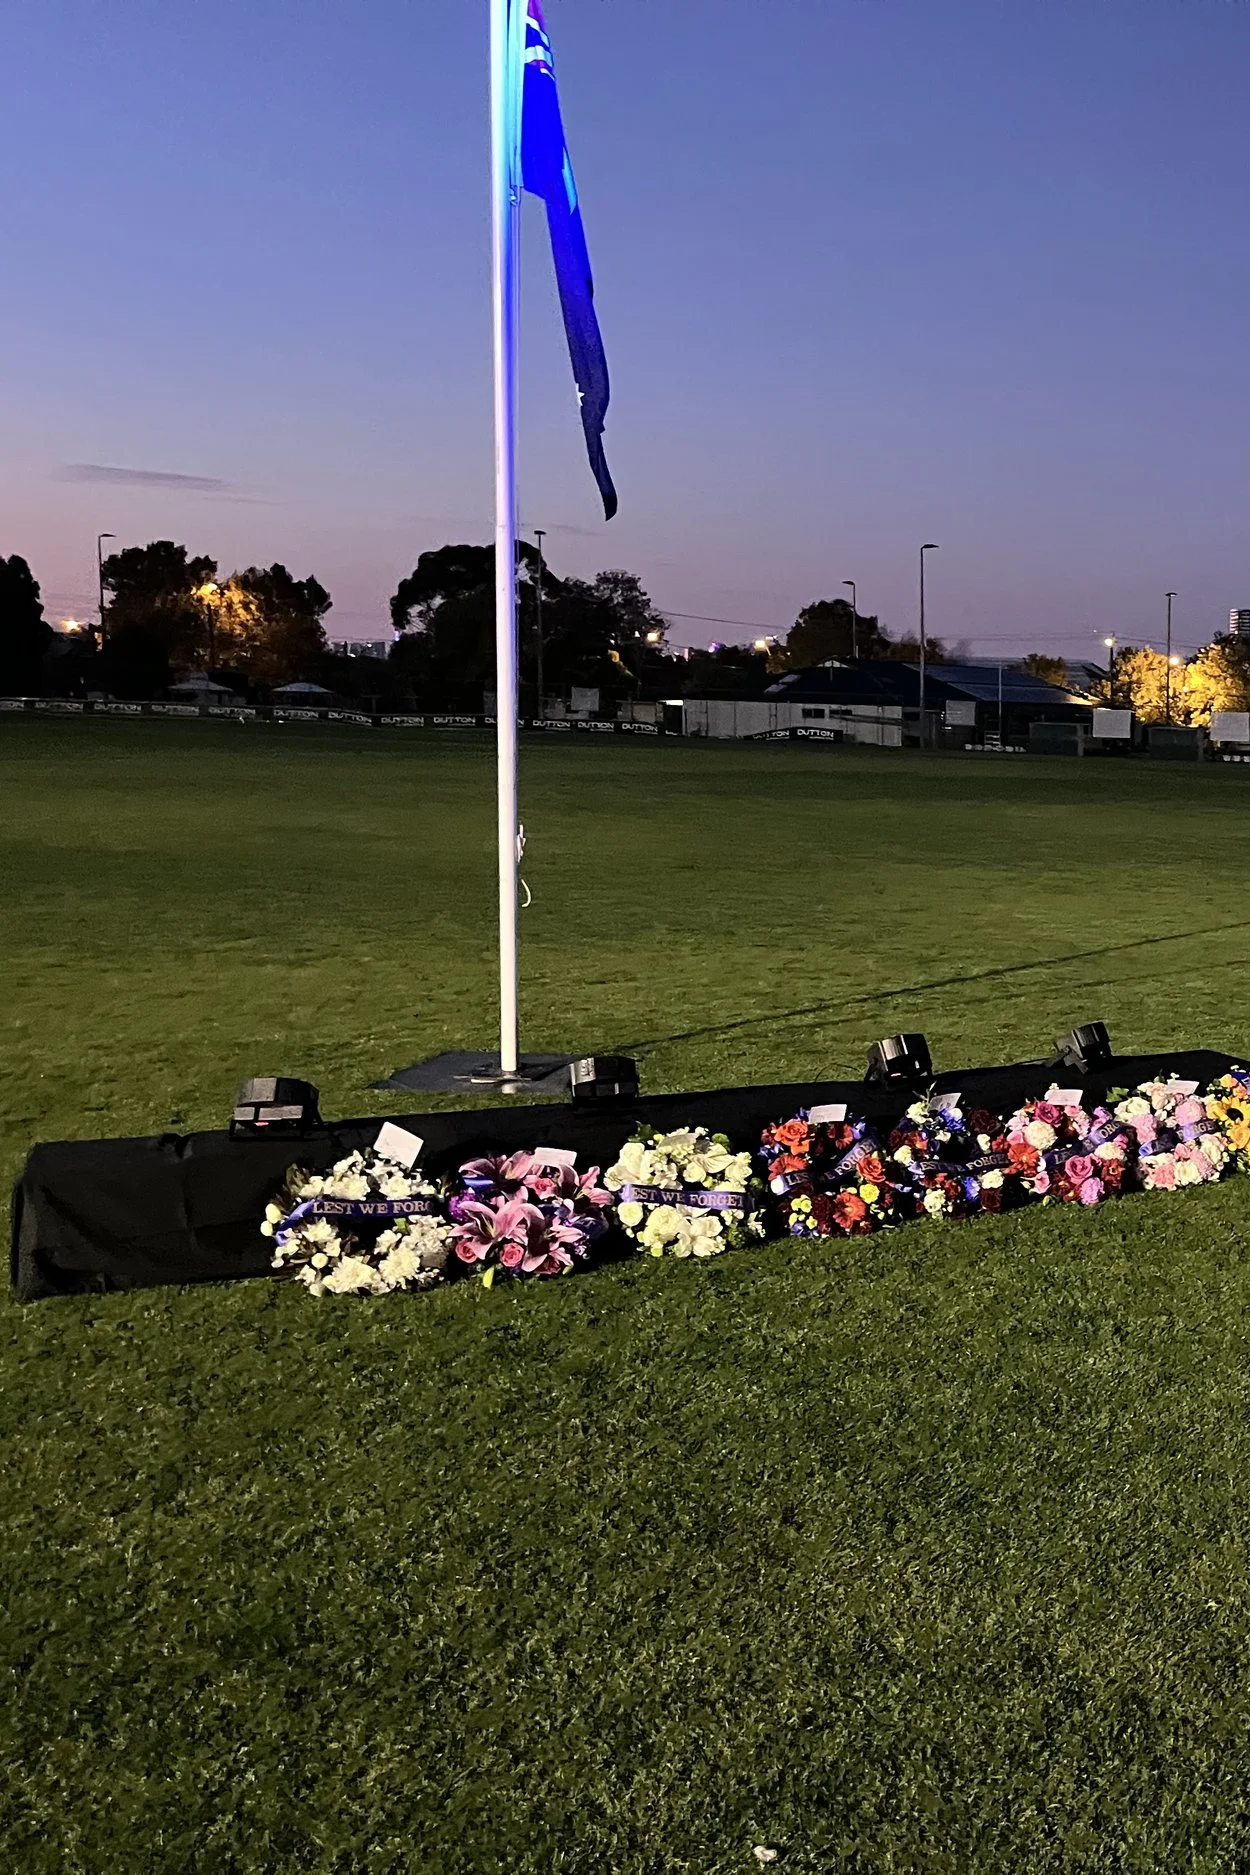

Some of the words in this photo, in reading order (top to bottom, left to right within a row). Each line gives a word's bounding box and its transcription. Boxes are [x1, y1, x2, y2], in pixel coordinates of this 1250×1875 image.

[433, 716, 477, 724] DUTTON
[532, 719, 571, 728] DUTTON
[577, 721, 615, 730] DUTTON
[621, 722, 658, 732] DUTTON
[796, 728, 835, 737] DUTTON
[312, 1201, 354, 1215] LEST
[359, 1202, 388, 1214] WE
